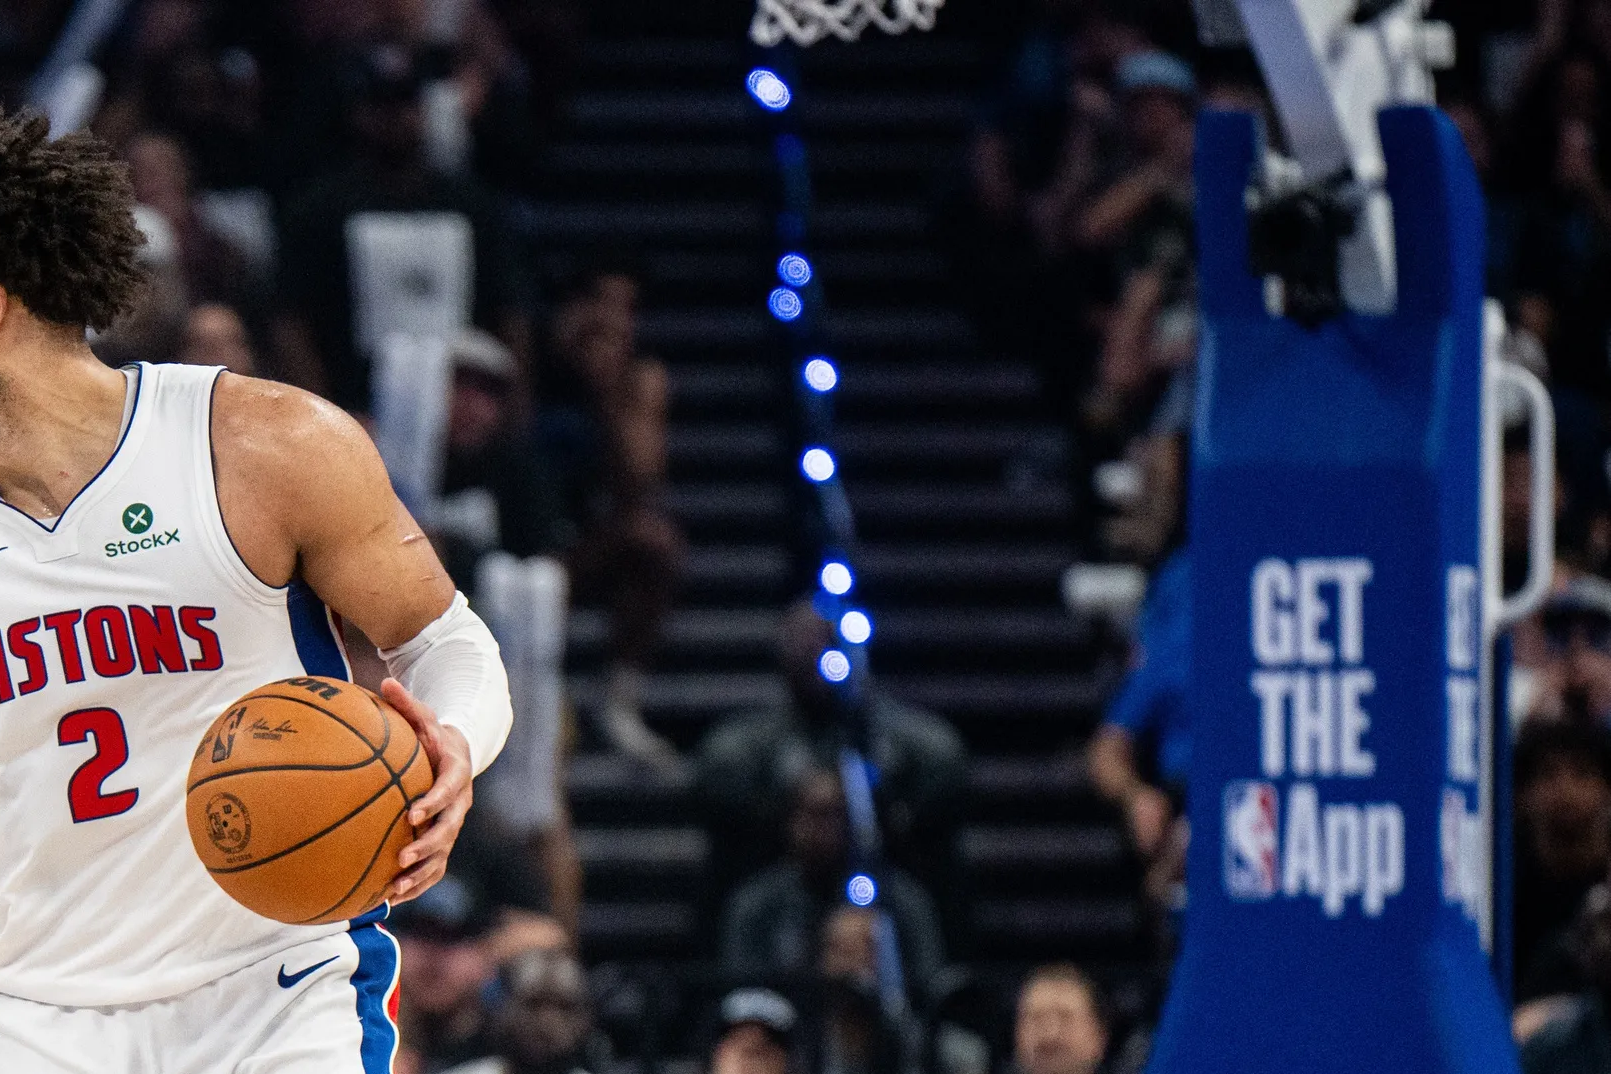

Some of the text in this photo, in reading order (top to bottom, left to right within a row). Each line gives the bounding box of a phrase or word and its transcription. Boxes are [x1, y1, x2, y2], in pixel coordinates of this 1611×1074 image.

[104, 528, 181, 558] StockX
[1251, 558, 1374, 666] GET
[57, 706, 139, 824] 2
[1250, 668, 1377, 777] THE
[1282, 780, 1405, 920] App
